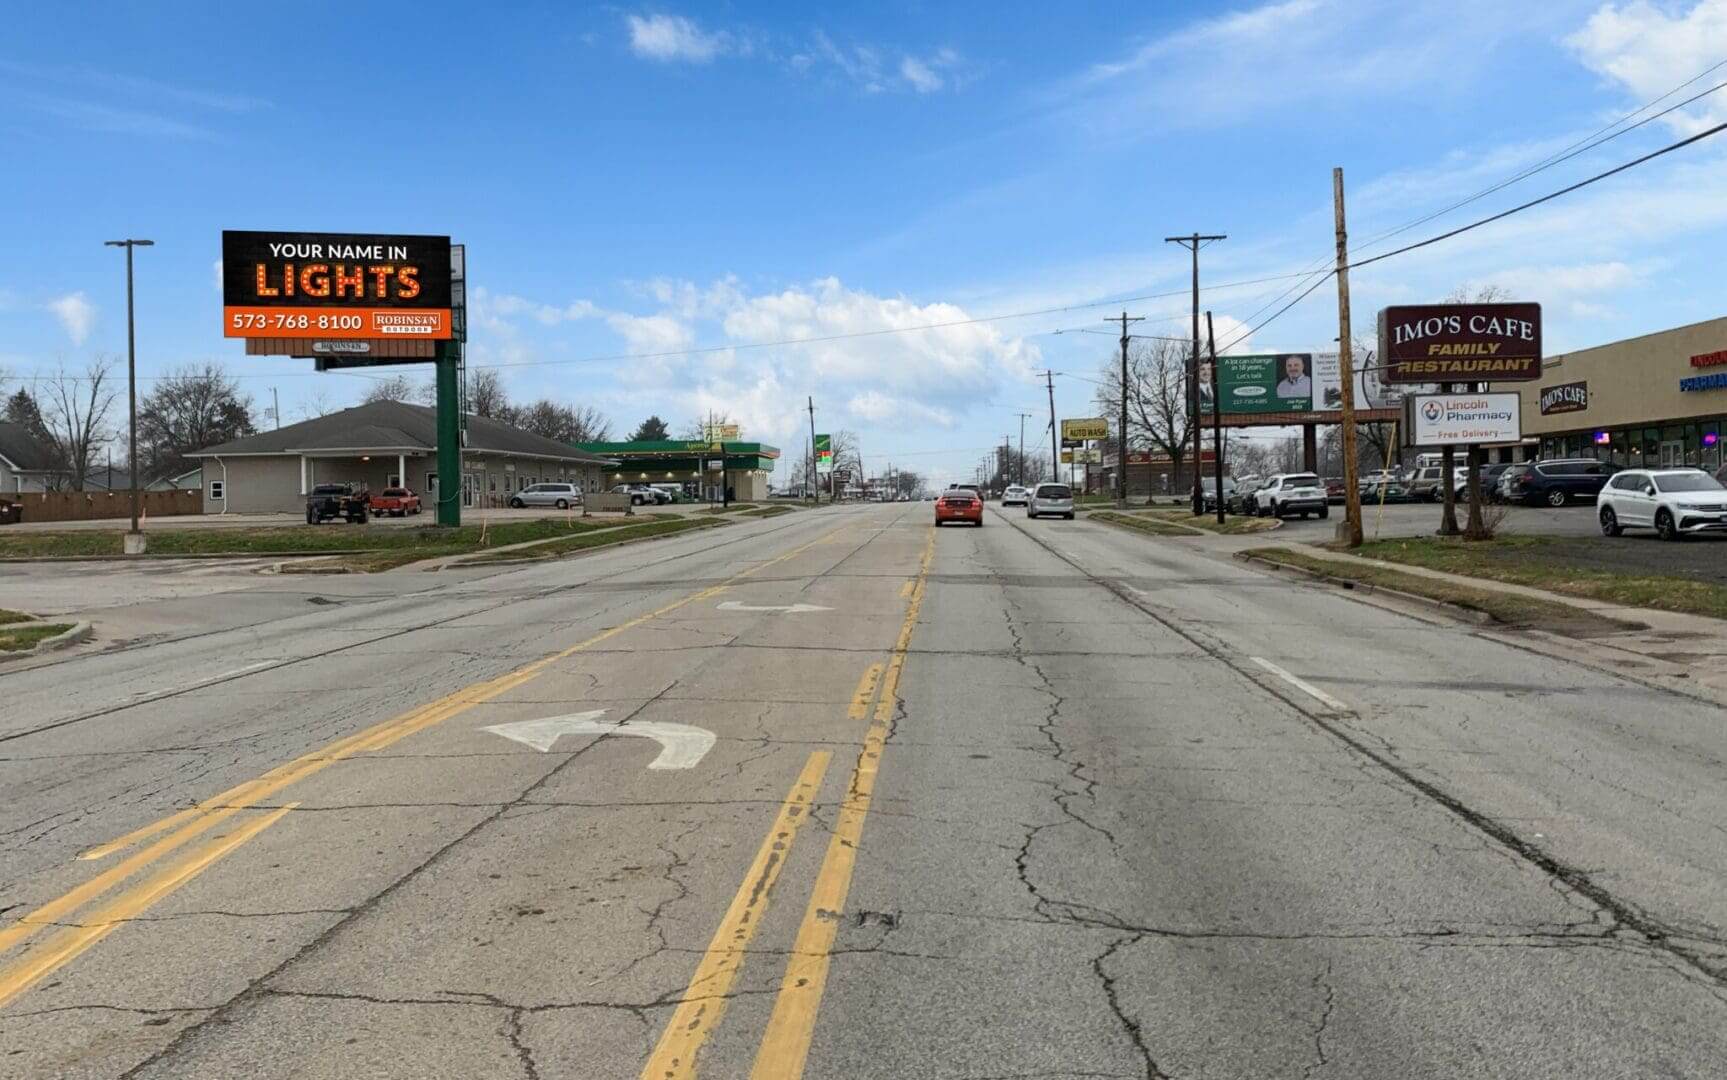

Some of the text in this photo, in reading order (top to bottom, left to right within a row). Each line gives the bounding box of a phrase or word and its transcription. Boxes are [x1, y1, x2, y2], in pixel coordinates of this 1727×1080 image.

[269, 242, 407, 260] YOUR NAME IN
[256, 263, 420, 298] LIGHTS
[233, 313, 362, 329] 573-768-8100
[1393, 315, 1534, 344] IMO'S CAFE
[1427, 342, 1501, 356] FAMILY
[1397, 358, 1533, 373] RESTAURANT
[1565, 386, 1586, 405] CAFE
[1446, 399, 1489, 410] Lincoln
[1447, 411, 1512, 422] Pharmacy
[1070, 428, 1105, 437] AUTO WASH
[1438, 430, 1499, 439] Free Delivery
